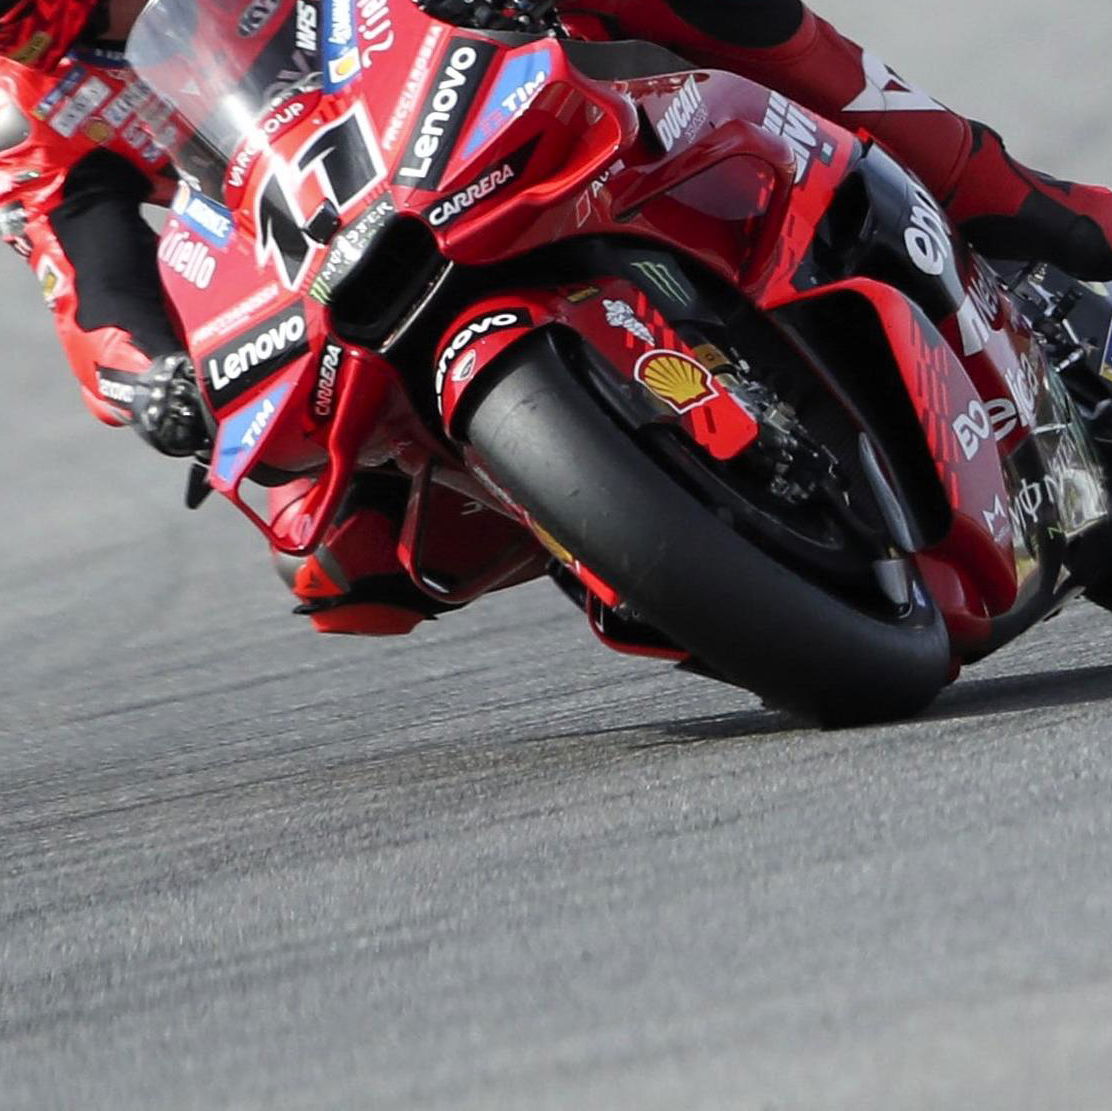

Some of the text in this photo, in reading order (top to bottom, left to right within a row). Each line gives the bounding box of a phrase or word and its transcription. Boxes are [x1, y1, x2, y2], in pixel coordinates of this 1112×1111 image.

[296, 0, 317, 50] WRS
[400, 46, 477, 178] Lenovo
[502, 71, 546, 112] TIM
[657, 74, 702, 153] DUCATI
[429, 164, 514, 226] CARRERA
[208, 315, 304, 390] Lenovo
[316, 345, 342, 416] CARRERA
[240, 399, 275, 447] TIM
